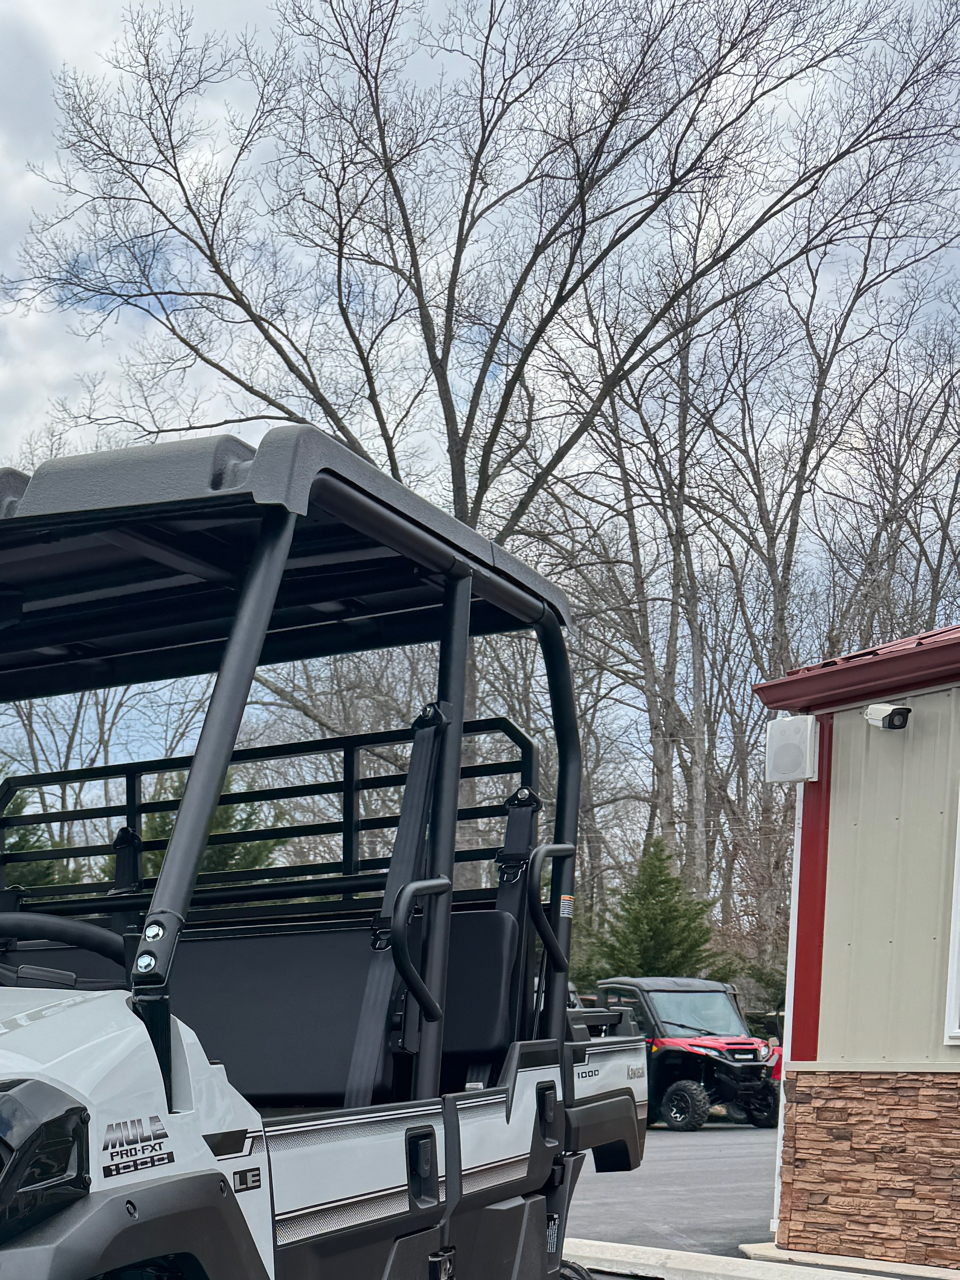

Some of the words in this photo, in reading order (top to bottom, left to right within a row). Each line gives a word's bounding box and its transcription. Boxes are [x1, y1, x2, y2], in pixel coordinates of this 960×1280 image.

[577, 1069, 599, 1079] 1000
[102, 1115, 169, 1151] MULE
[110, 1155, 169, 1175] 1000
[233, 1170, 260, 1190] LE
